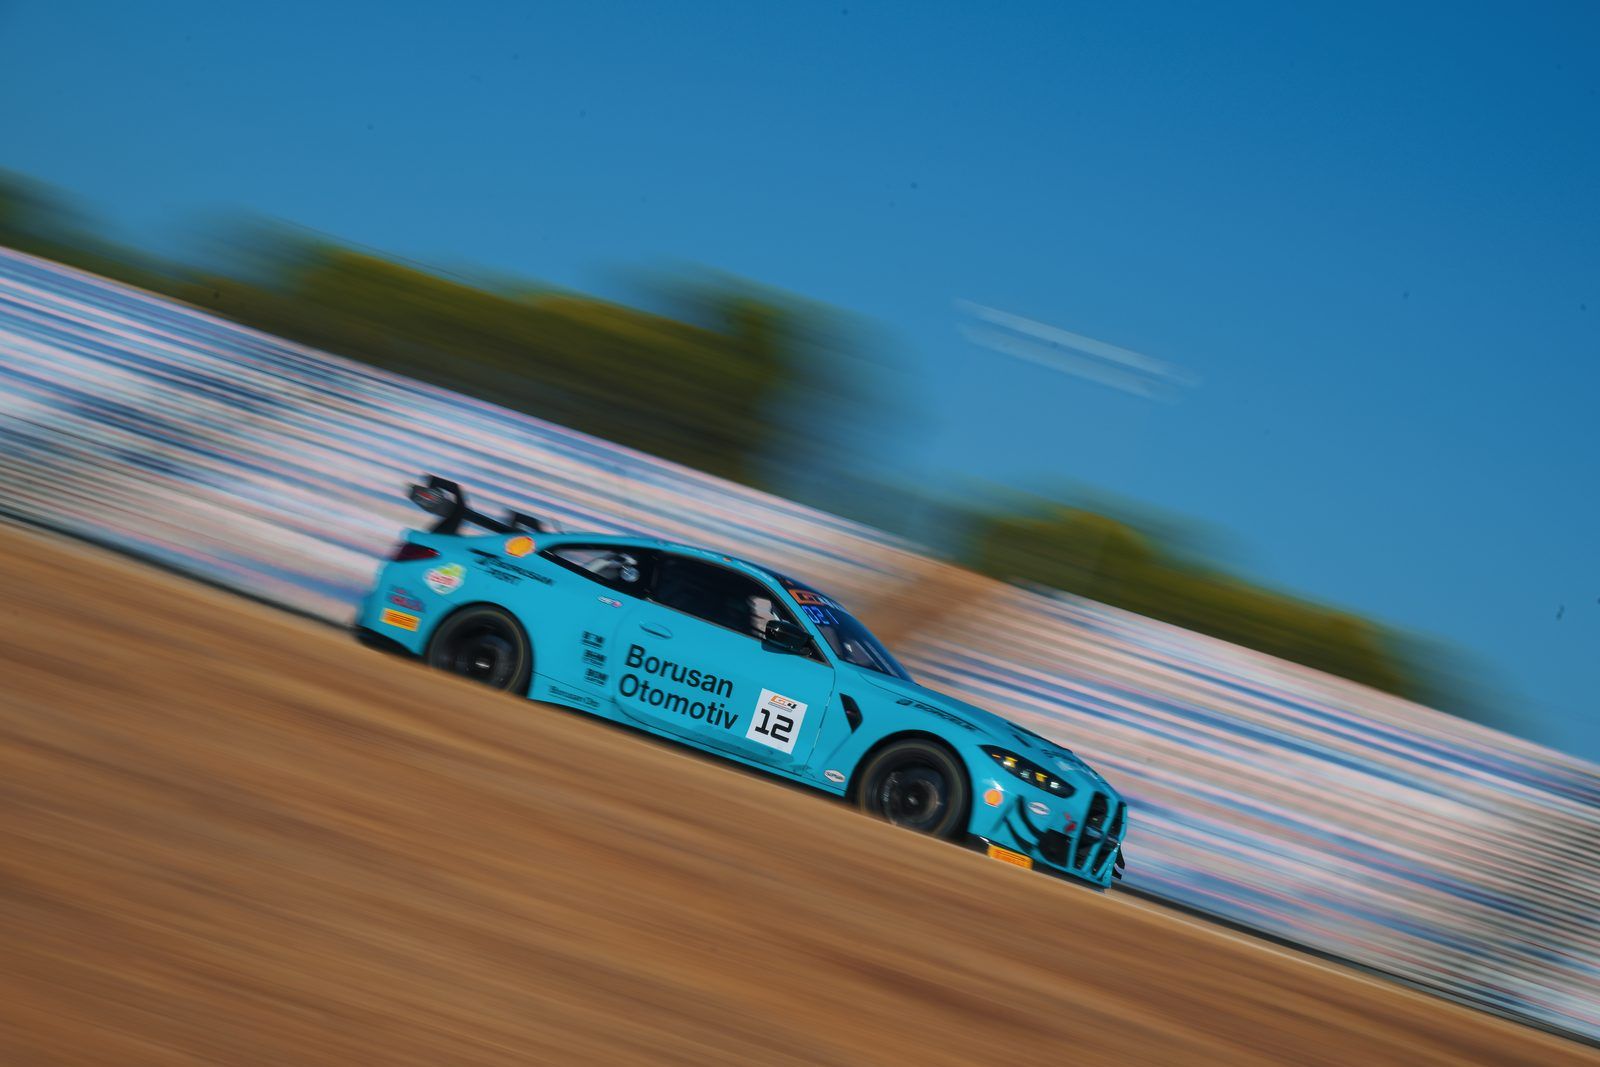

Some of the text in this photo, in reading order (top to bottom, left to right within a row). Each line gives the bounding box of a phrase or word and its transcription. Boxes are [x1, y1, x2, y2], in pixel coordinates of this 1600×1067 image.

[624, 644, 734, 698] Borusan
[619, 673, 739, 730] Otomotiv
[754, 708, 794, 743] 12
